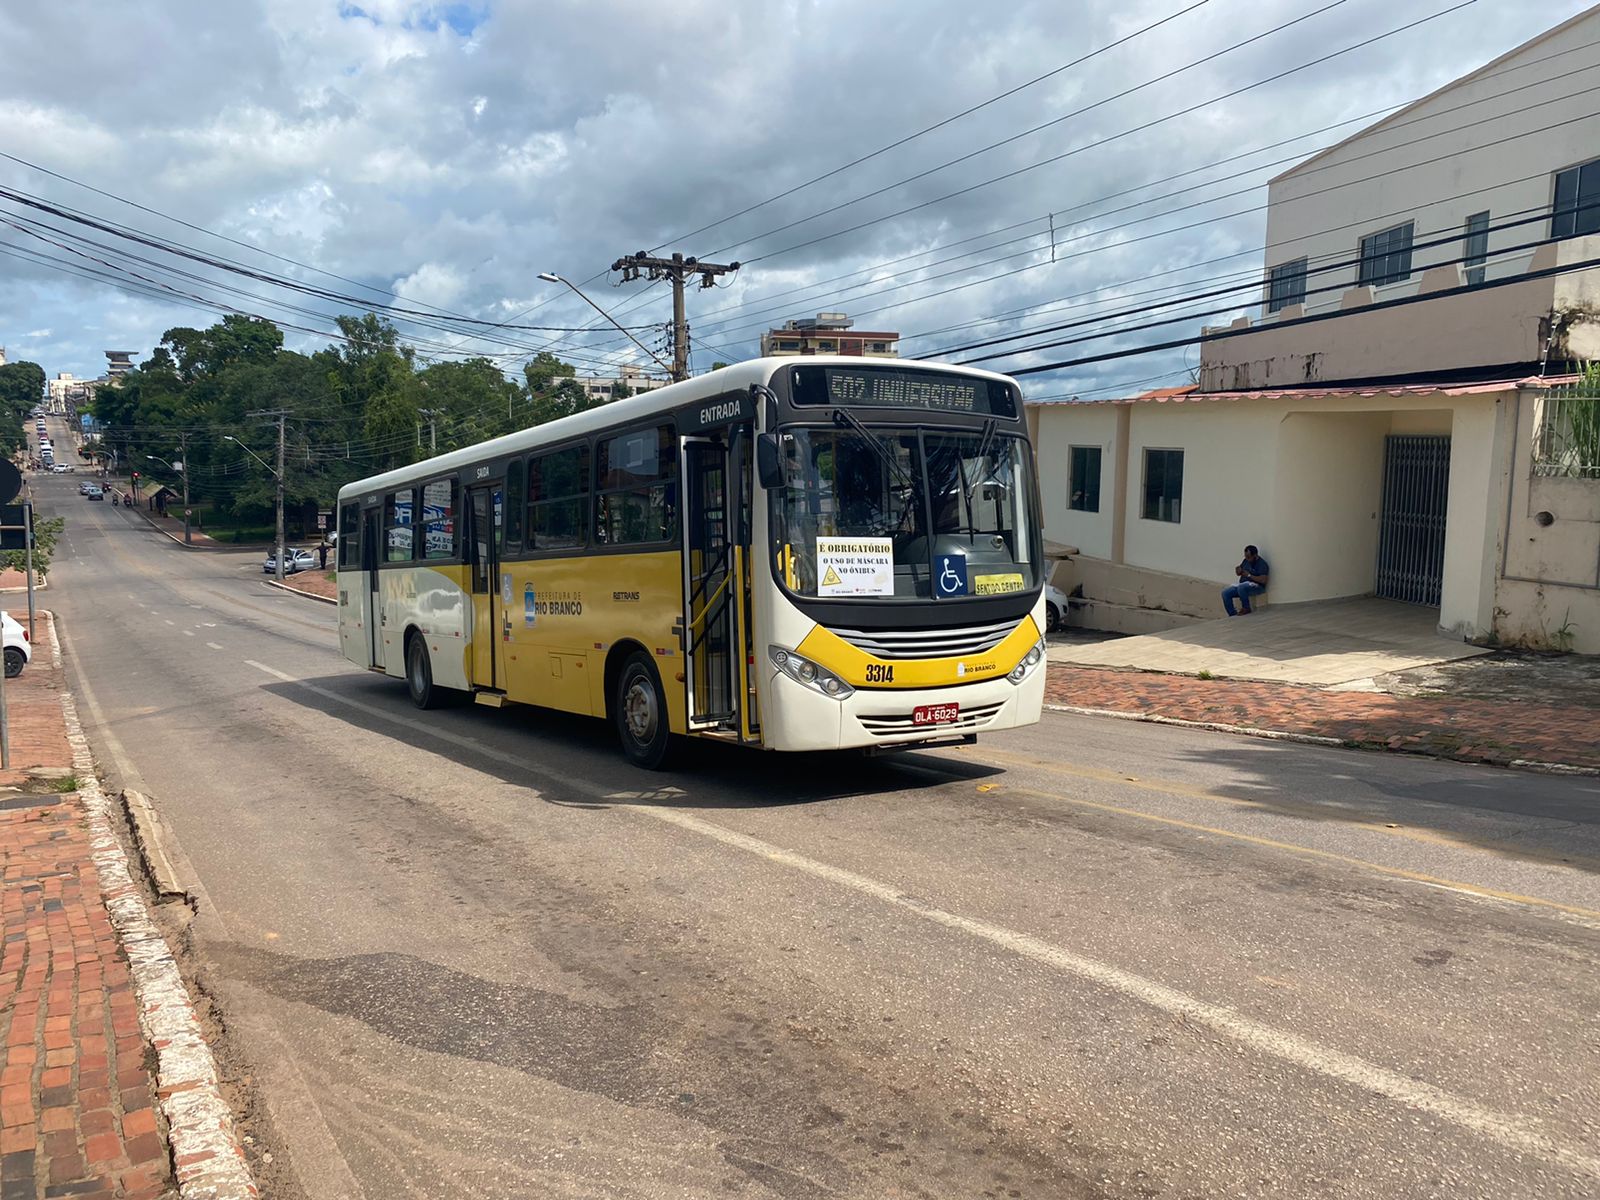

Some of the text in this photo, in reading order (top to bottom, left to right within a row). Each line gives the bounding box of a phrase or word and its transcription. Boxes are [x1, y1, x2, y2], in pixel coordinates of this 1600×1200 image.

[700, 400, 741, 424] ENTRADA
[819, 542, 891, 553] É OBRIGATÓRIO
[574, 592, 582, 600] DE
[534, 602, 582, 615] RIO BRANCO
[866, 664, 894, 683] 3314
[975, 664, 997, 672] BRANCO
